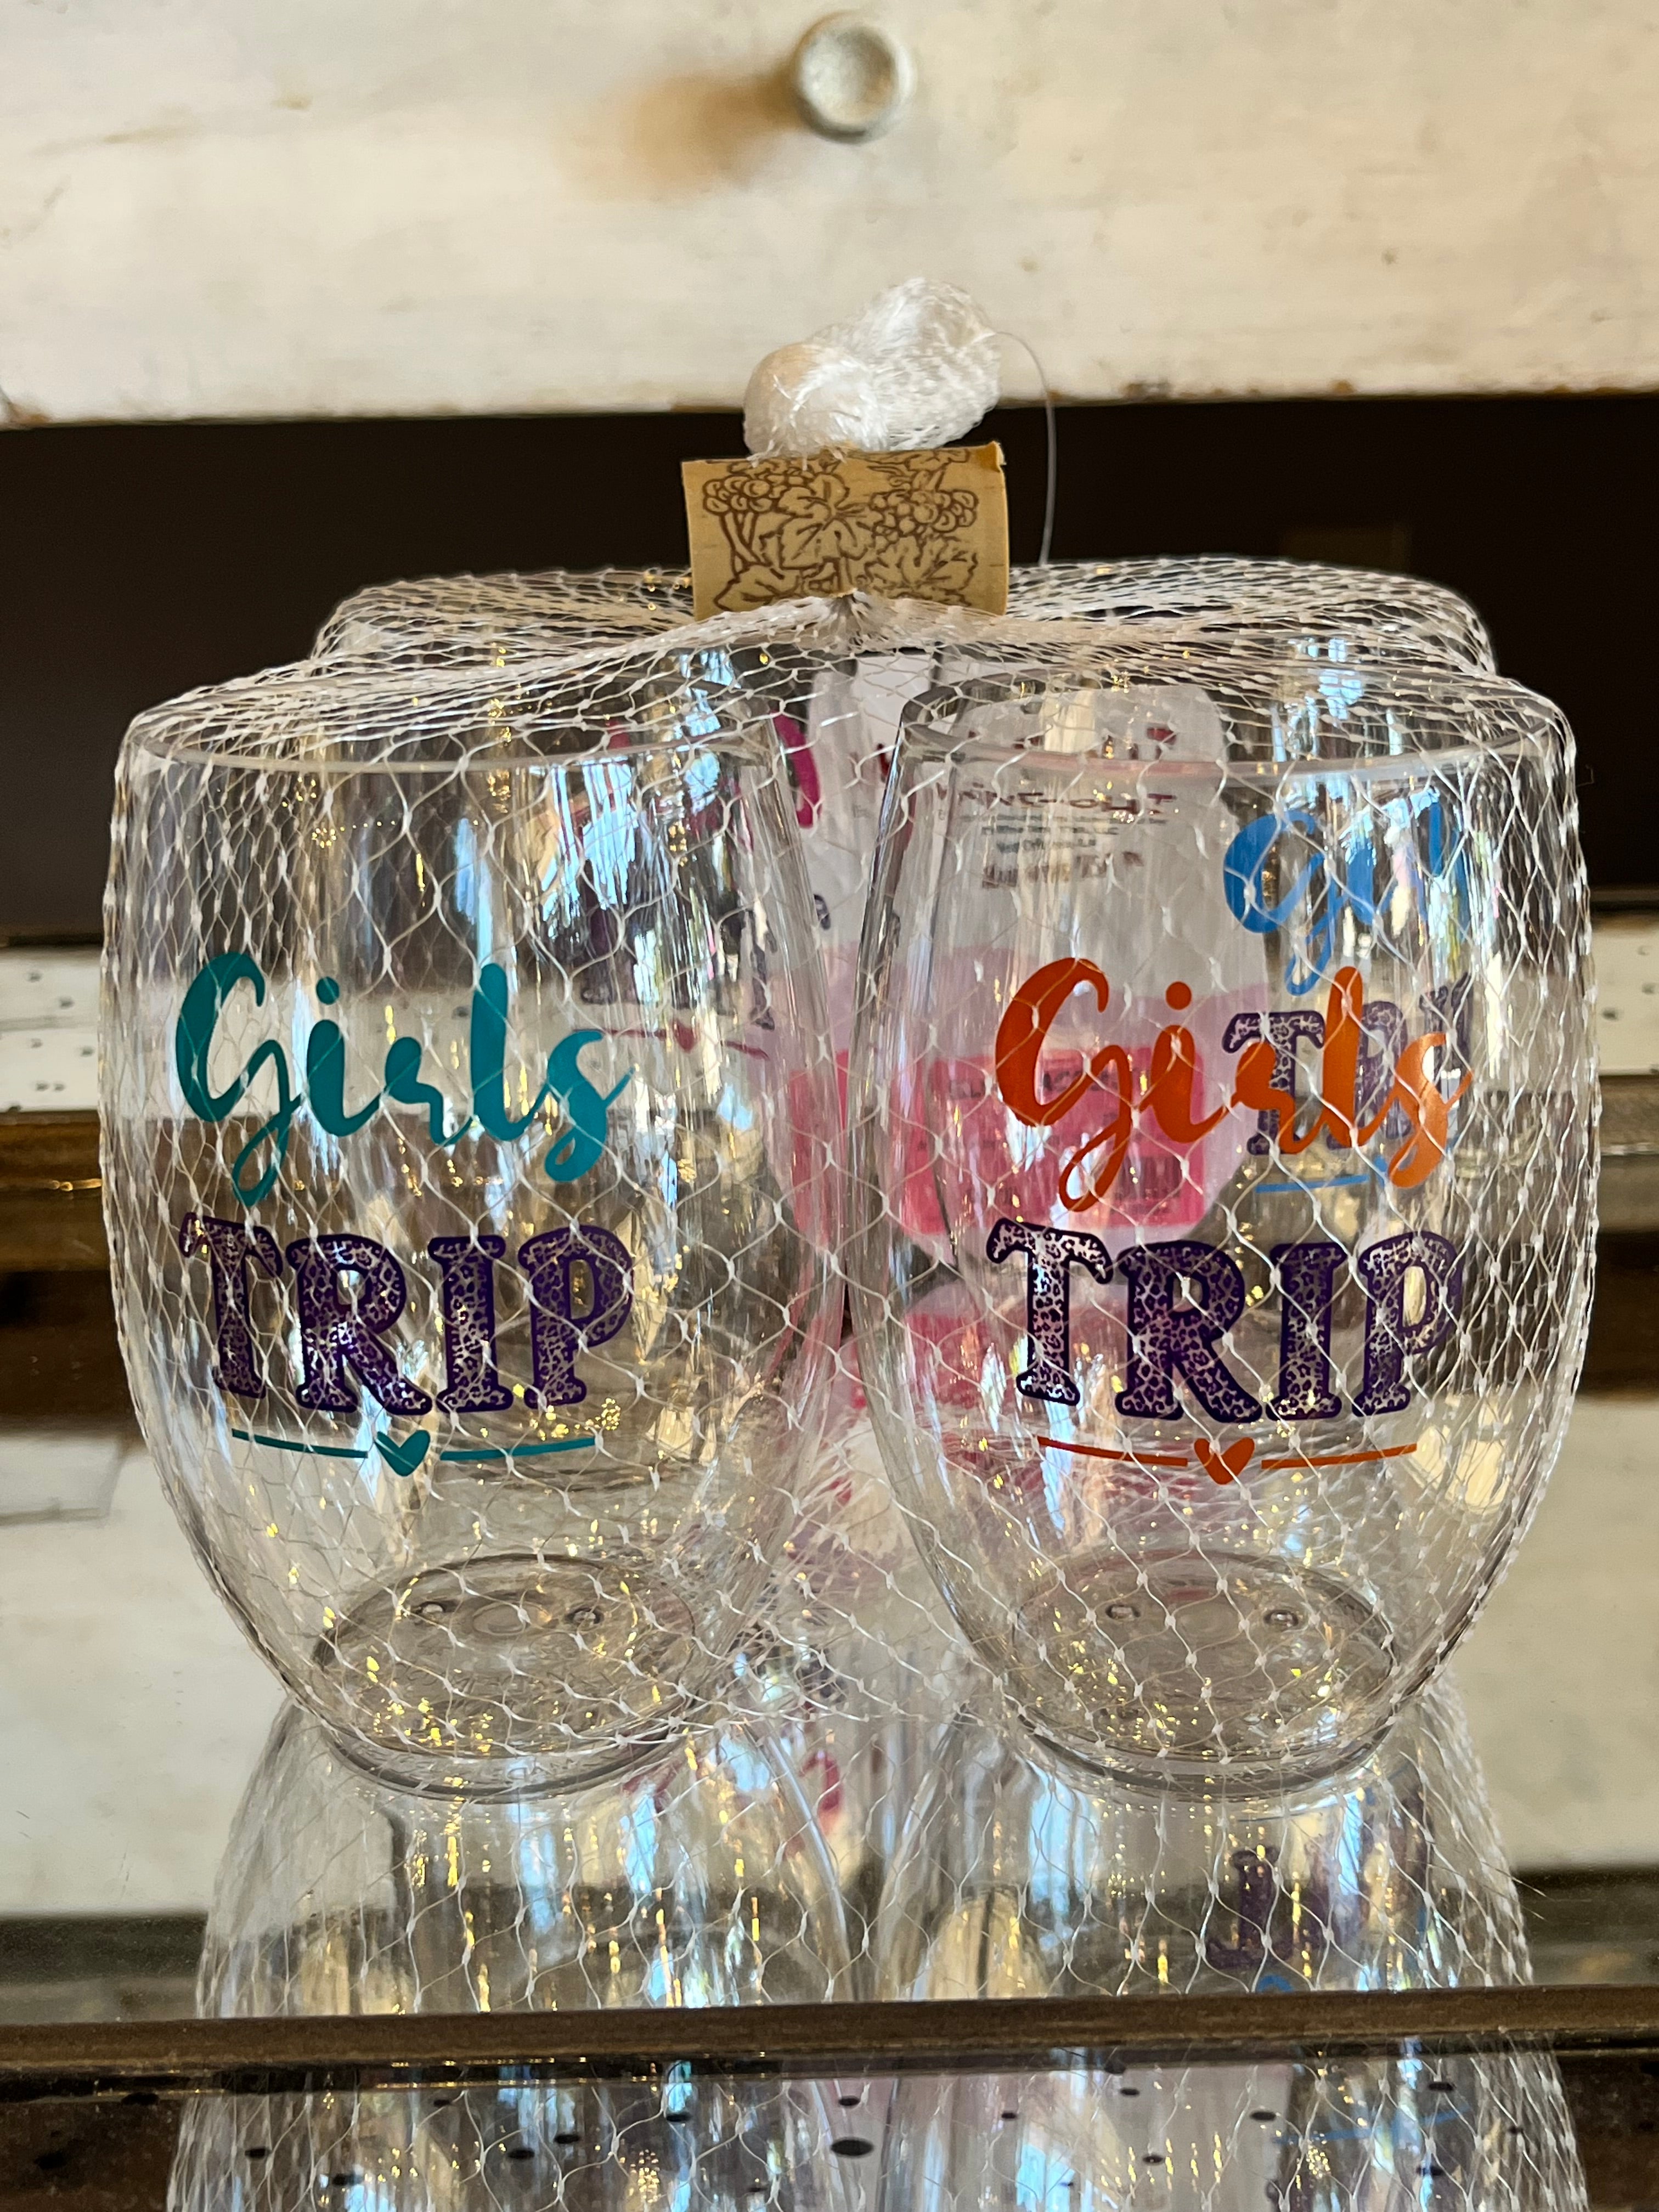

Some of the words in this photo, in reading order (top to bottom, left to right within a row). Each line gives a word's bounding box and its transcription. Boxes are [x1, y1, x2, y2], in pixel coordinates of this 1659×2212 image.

[176, 951, 635, 1206] Girls
[995, 957, 1474, 1212] Girls
[179, 1211, 634, 1415] TRIP
[987, 1218, 1463, 1424] TRIP
